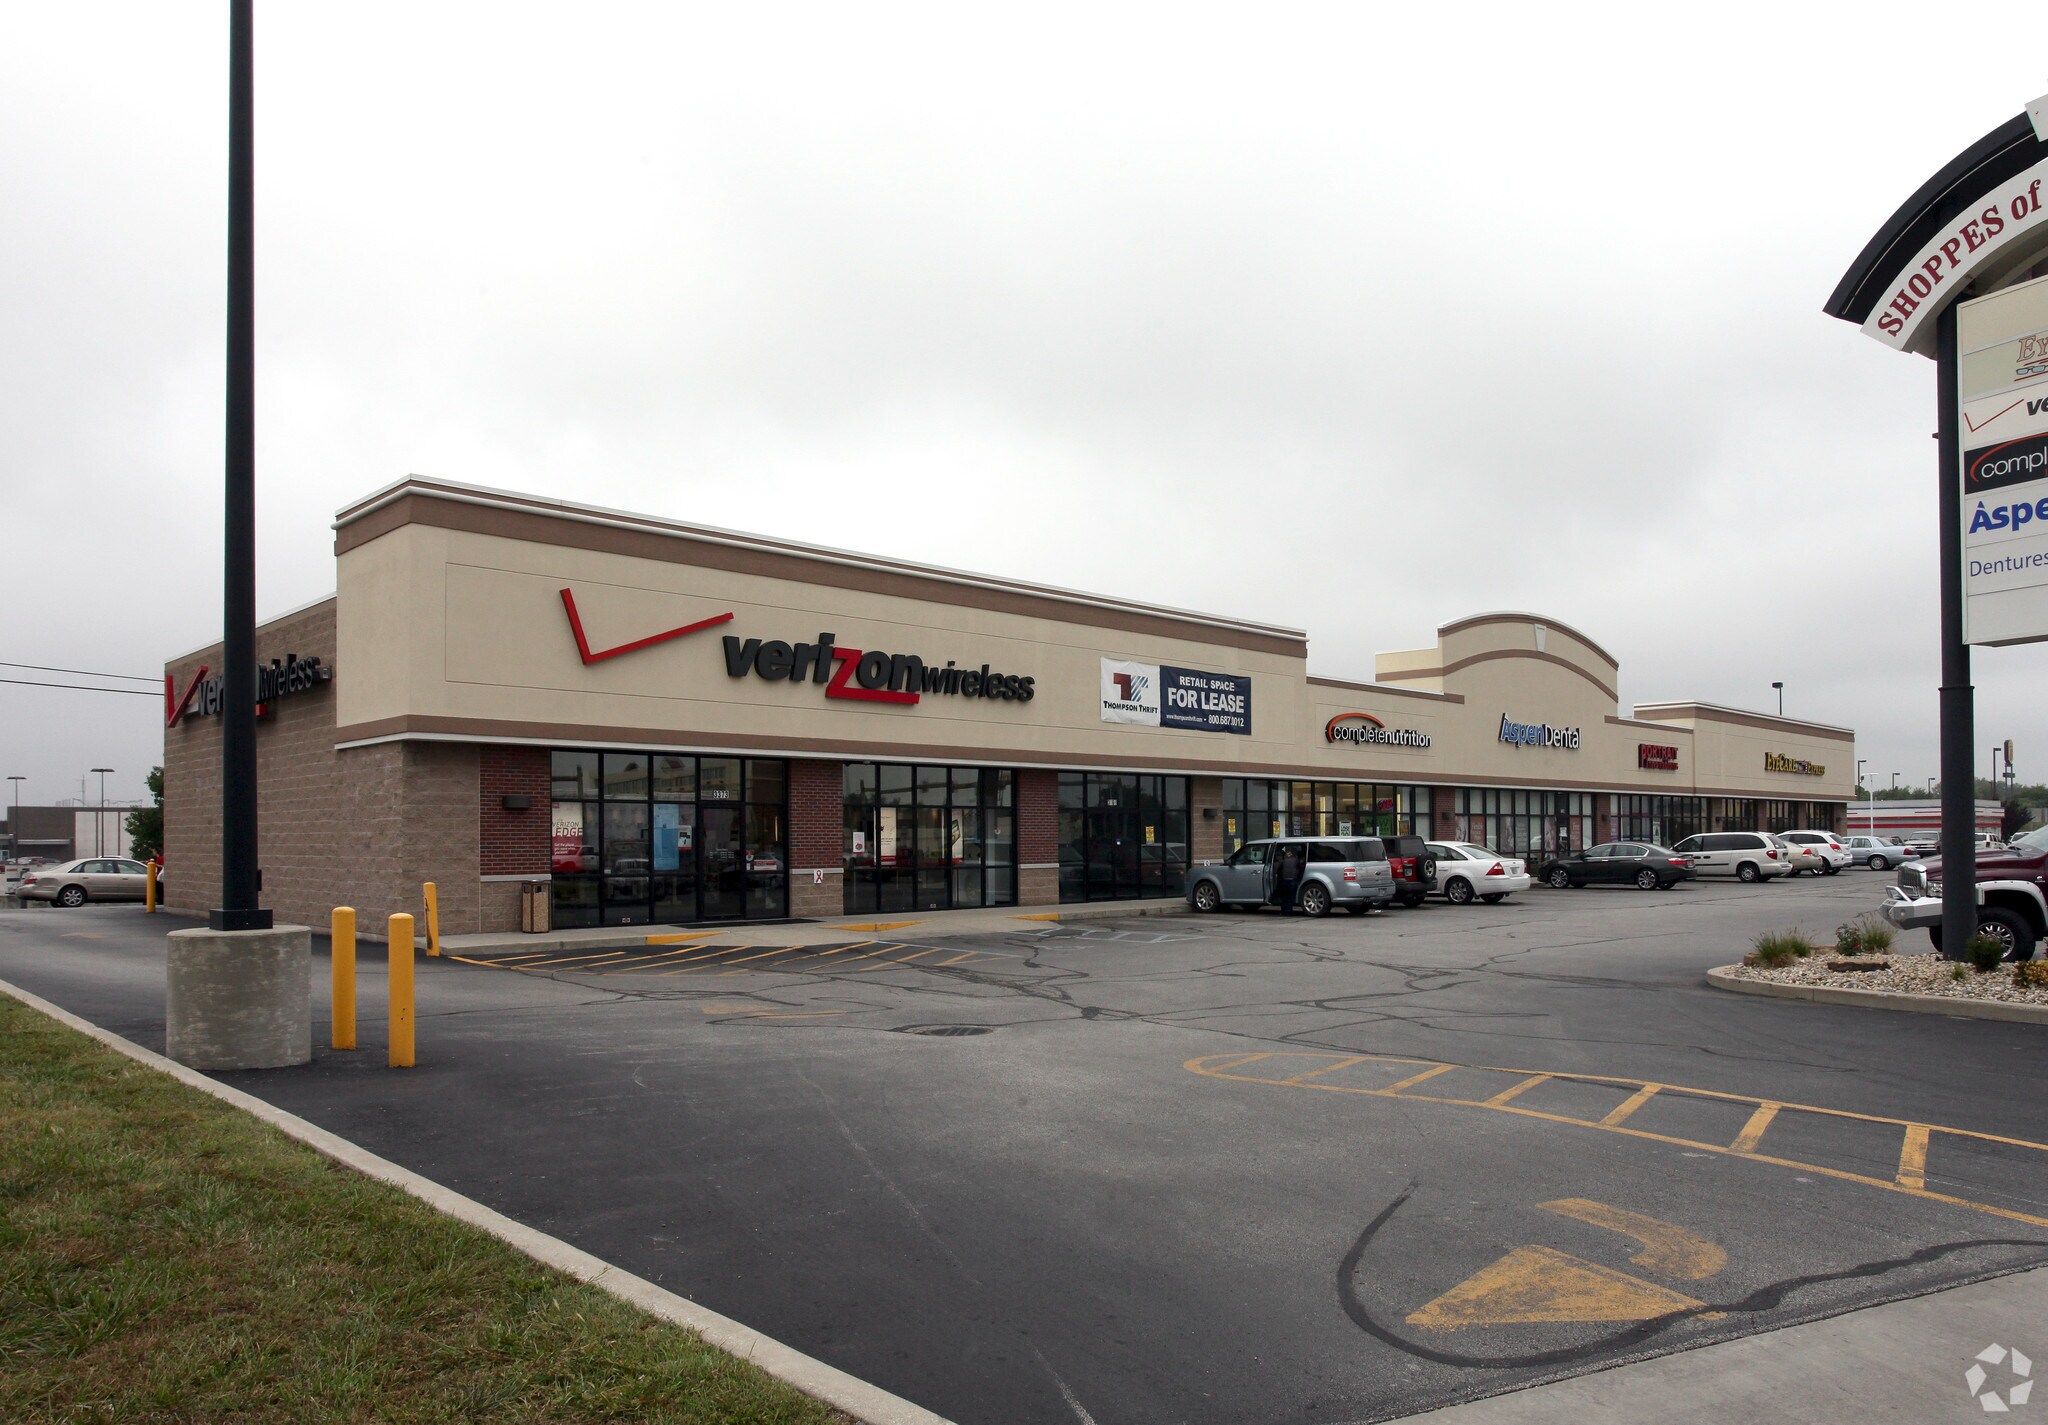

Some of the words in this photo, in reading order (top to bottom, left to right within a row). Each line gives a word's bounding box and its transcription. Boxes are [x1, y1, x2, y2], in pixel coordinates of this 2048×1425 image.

[1877, 205, 2005, 338] SHOPPES
[2010, 179, 2043, 221] of
[1981, 446, 2048, 479] compl
[1179, 676, 1208, 689] RETAIL
[1210, 680, 1235, 691] SPACE
[1168, 688, 1198, 709] FOR
[1201, 693, 1244, 713] LEASE
[556, 828, 583, 837] EDGE
